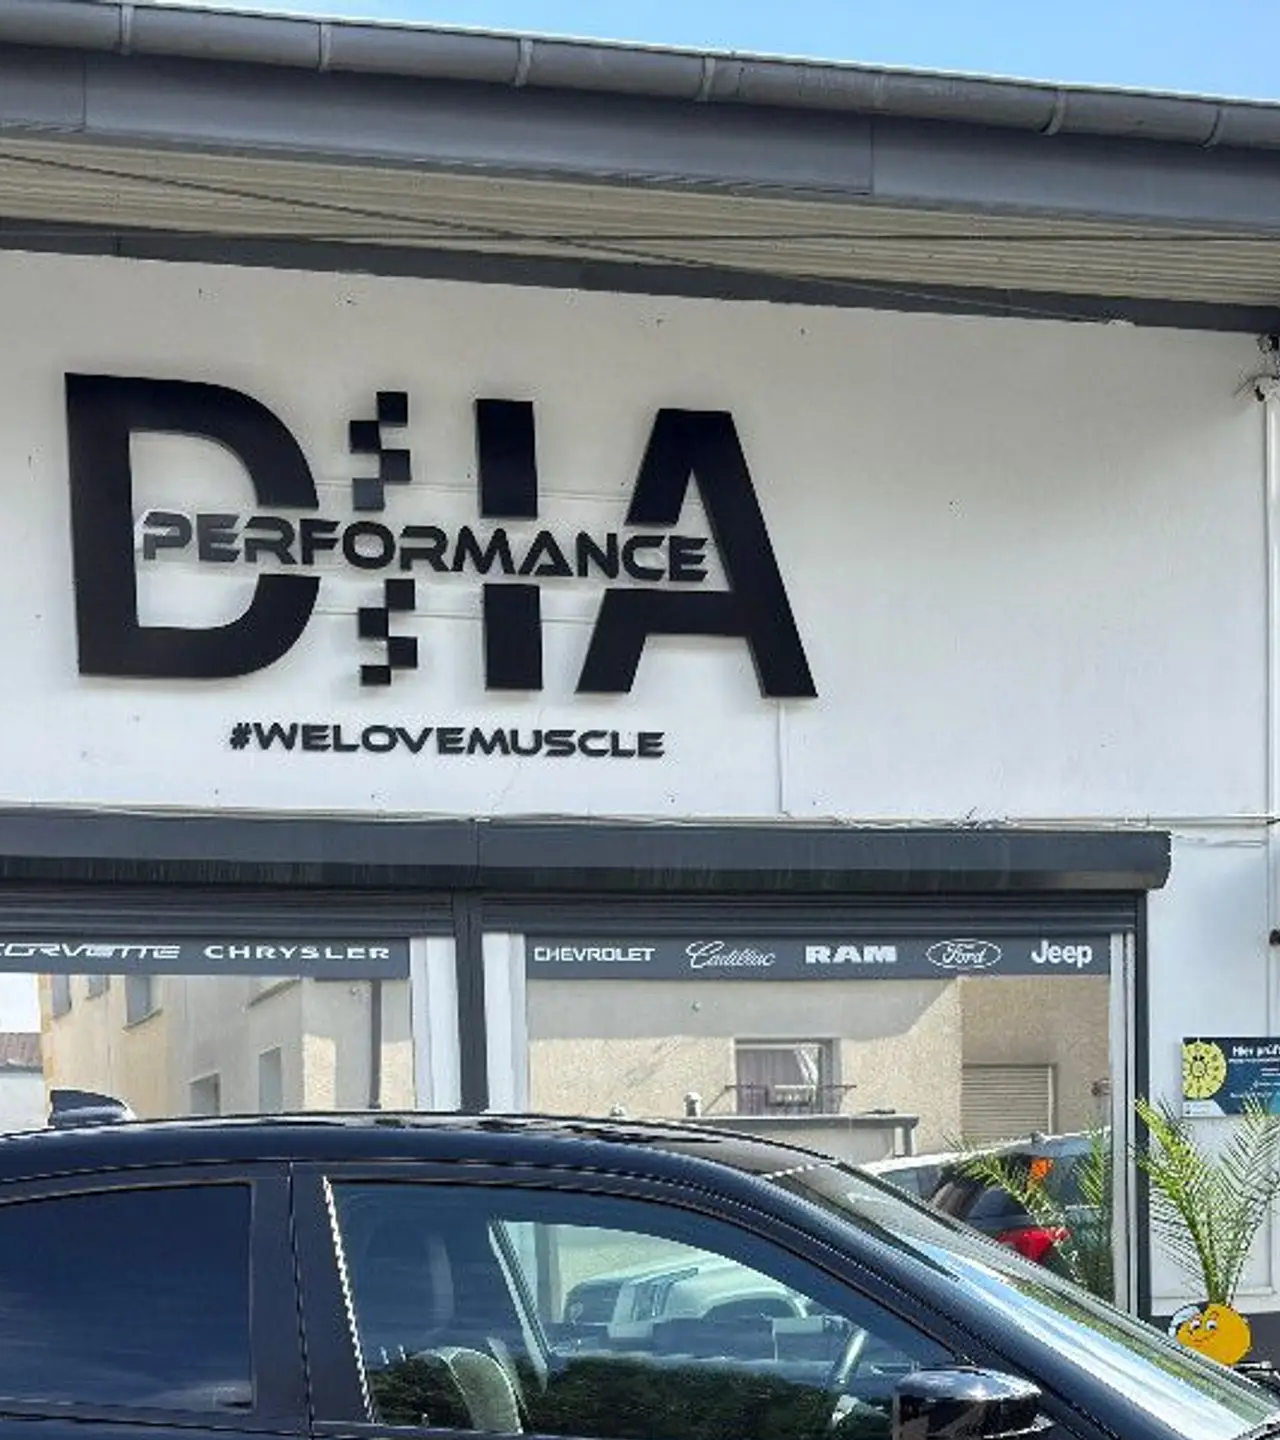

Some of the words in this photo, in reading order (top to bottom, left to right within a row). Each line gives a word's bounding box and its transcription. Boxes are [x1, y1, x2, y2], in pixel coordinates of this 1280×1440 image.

[141, 511, 709, 582] PERFORMANCE
[229, 721, 666, 758] #WELOVEMUSCLE
[204, 944, 390, 960] CHRYSLER
[533, 946, 655, 963] CHEVROLET
[685, 940, 777, 968] Cadillac
[805, 945, 898, 963] RAM
[1031, 940, 1093, 967] Jeep
